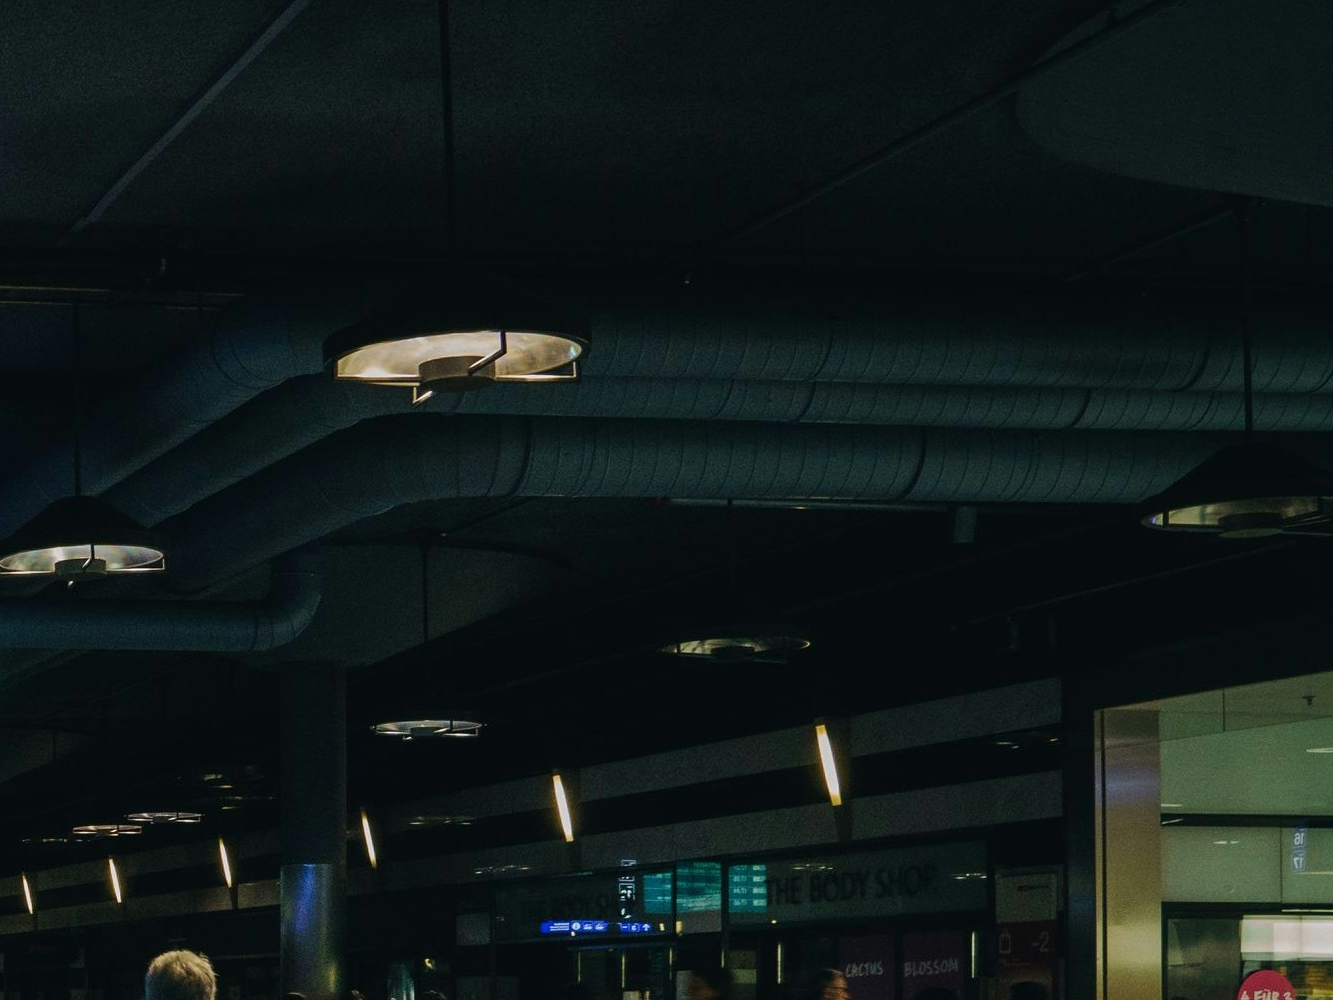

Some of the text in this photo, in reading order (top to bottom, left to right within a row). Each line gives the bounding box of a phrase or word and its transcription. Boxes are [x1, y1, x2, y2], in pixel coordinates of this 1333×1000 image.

[766, 876, 803, 906] THE
[810, 869, 871, 903] BODY
[845, 961, 884, 978] CACTUS
[904, 958, 959, 978] BLOSSOM
